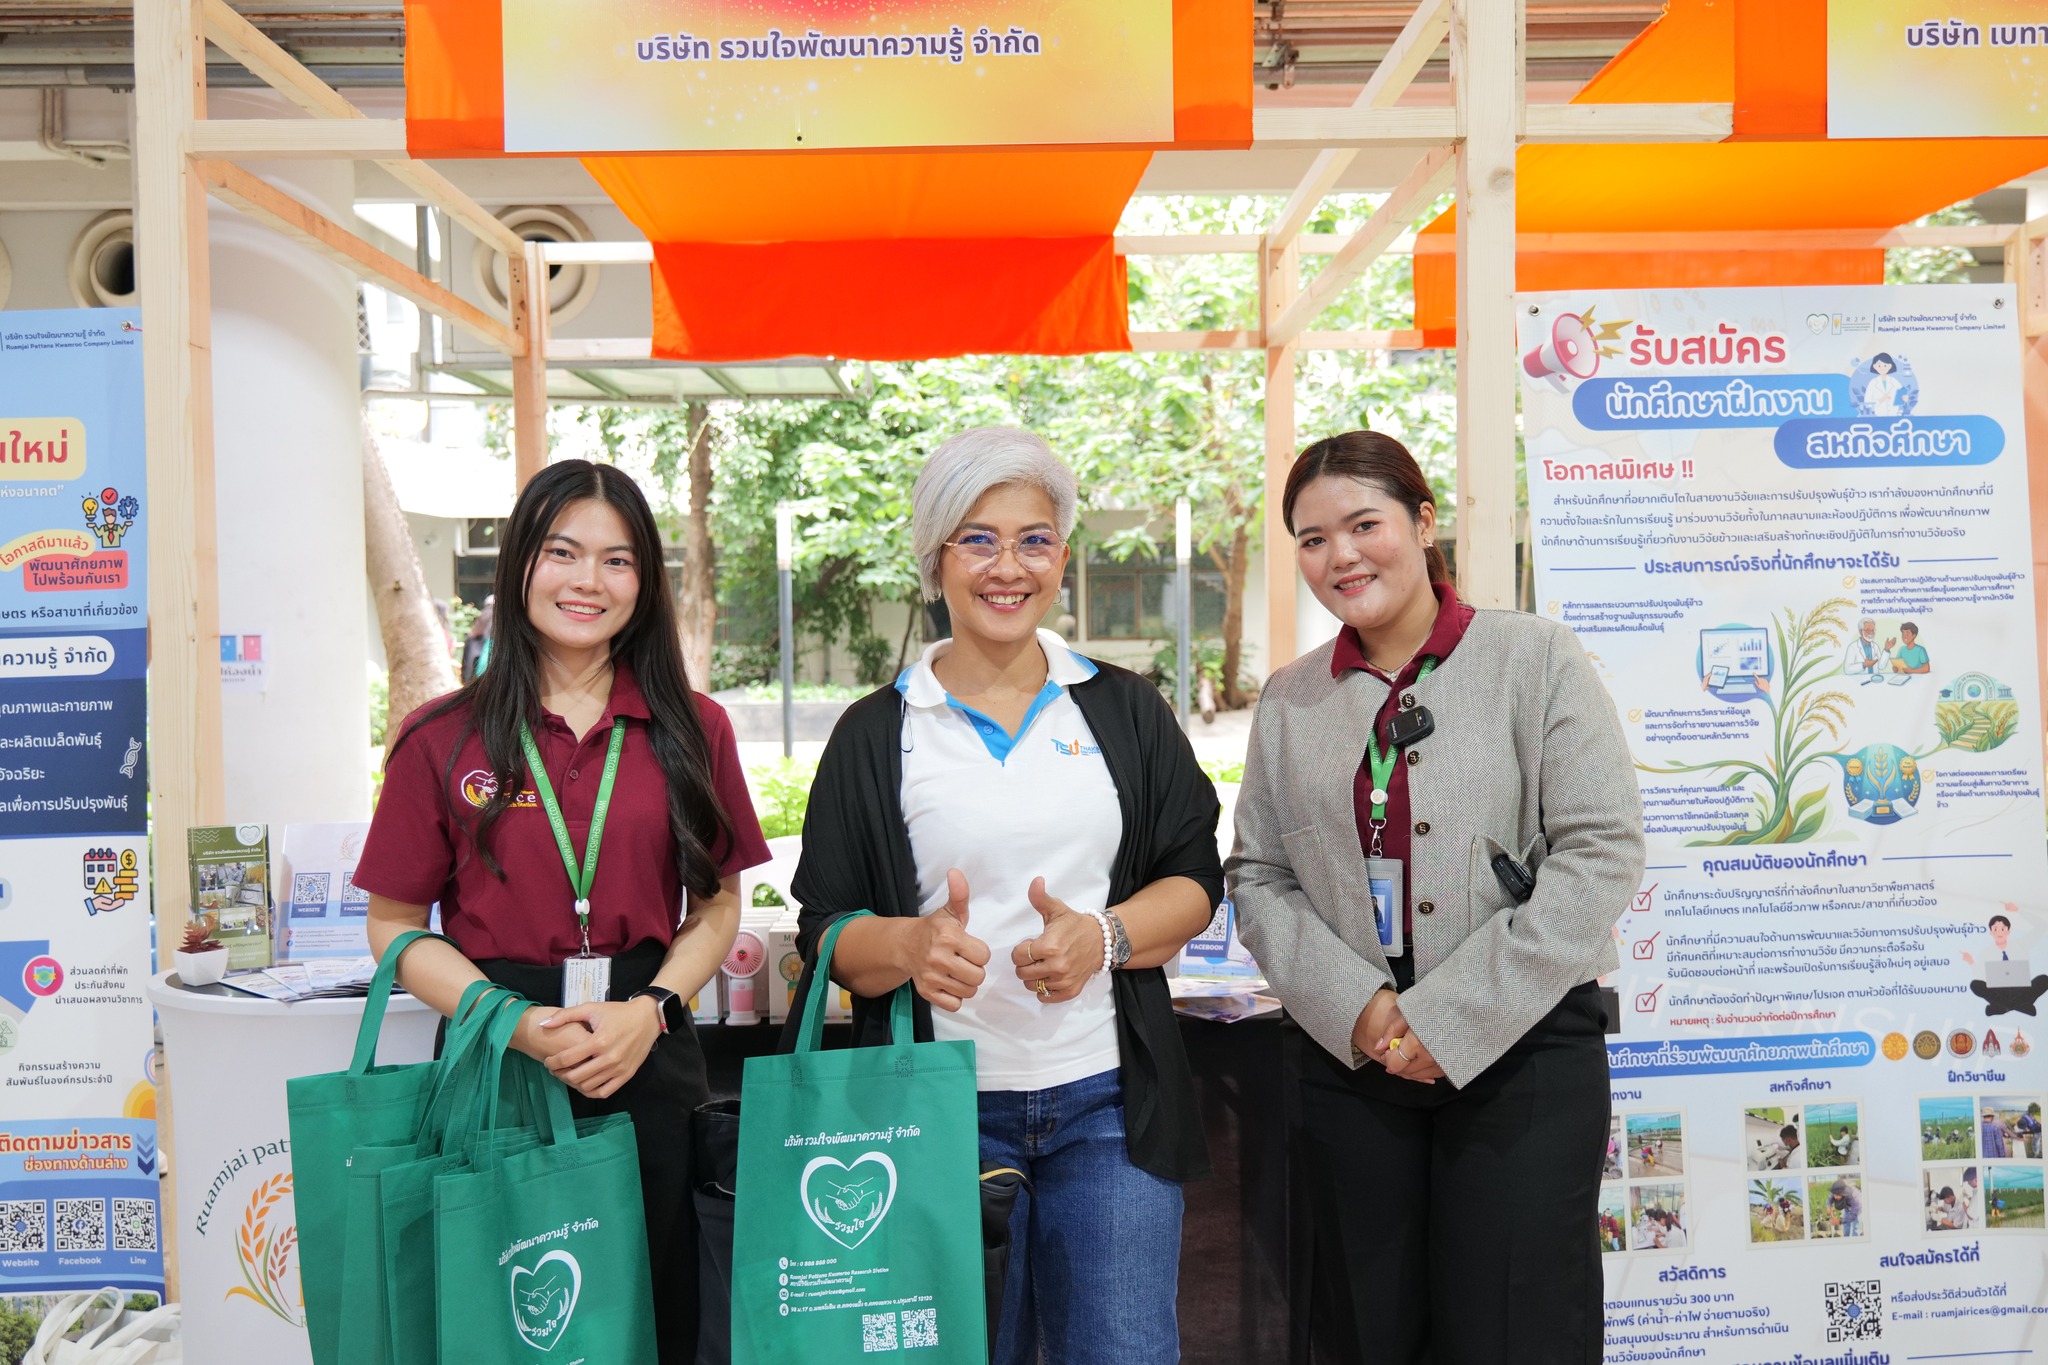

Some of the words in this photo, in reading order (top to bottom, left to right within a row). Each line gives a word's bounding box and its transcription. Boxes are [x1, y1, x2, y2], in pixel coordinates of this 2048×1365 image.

[1907, 20, 1979, 46] บริษัท
[636, 35, 711, 61] บริษัท
[720, 27, 964, 63] รวมใจพัฒนาความรู้
[973, 28, 1040, 57] จำกัด
[1954, 324, 1982, 332] Company
[1630, 323, 1786, 366] รับสมัคร
[1606, 378, 1832, 419] นักศึกษาฝึกงาน
[1806, 418, 1971, 459] สหกิจศึกษา
[1543, 459, 1675, 481] โอกาสพิเศษ
[1682, 460, 1694, 478] !!
[1553, 488, 1867, 506] สำหรับนักศึกษาที่อยากเติบโตในสายงานวิจัยและการปรับปรุงพันธุ์ข้าว
[1869, 482, 1995, 499] เรากำลังมองหานักศึกษาที่มี
[1540, 511, 1674, 527] ความตั้งใจและรักในการเรียนรู้
[1675, 507, 1898, 523] มาร่วมงานวิจัยทั้งในภาคสนามและห้องปฏิบัติการ
[1899, 504, 1990, 518] เพื่อพัฒนาศักยภาพ
[0, 535, 89, 566] โอกาสดีมาแล้ว
[29, 557, 123, 571] พัฒนาศักยภาพ
[1644, 549, 1900, 574] ประสบการณ์จริงที่นักศึกษาจะได้รับ
[33, 572, 121, 586] ไปพร้อมกับเรา
[31, 602, 138, 618] หรือสาขาที่เกี่ยวข้อง
[1572, 622, 1665, 633] รส่งเสริมและผลิตเมล็ดพันธุ์
[0, 647, 58, 669] ความรู้
[64, 647, 107, 664] จำกัด
[0, 700, 113, 716] ณภาพและกายภาพ
[1643, 796, 1754, 808] ุณภาพดินภายในห้องปฏิบัติการ
[546, 797, 575, 867] WWW.PINEHURST.CO.TH
[586, 800, 607, 871] WWW.PINEHURST.CO.TH
[1644, 822, 1747, 834] พื่อสนับสนุนงานปรับปรุงพันธุ์
[1703, 850, 1867, 877] คุณสมบัติของนักศึกษา
[1664, 880, 1935, 901] นักศึกษาระดับปริญญาตรีที่กำลังศึกษาในสาขาวิชาพืชศาสตร์
[1664, 904, 1740, 917] เทคโนโลยีเกษตร
[1742, 901, 1820, 914] เทคโนโลยีชีวภาพ
[1822, 893, 1938, 911] หรือคณะ/สาขาที่เกี่ยวข้อง
[1666, 923, 1987, 946] นักศึกษาที่มีความสนใจด้านการพัฒนาและวิจัยทางการปรับปรุงพันธุ์ข้าว
[1190, 943, 1224, 951] FACEBOOK
[1666, 945, 1838, 962] มีทัศนคติที่เหมาะสมต่อการทำงานวิจัย
[1839, 941, 1925, 955] มีความกระตือรือร้น
[70, 963, 128, 976] ส่วนลดค่าที่พัก
[1667, 962, 1756, 978] รับผิดชอบต่อหน้าที่
[1758, 957, 1912, 975] และพร้อมเปิดรับการเรียนรู้สิ่งใหม่ๆ
[1913, 956, 1950, 972] อยู่เสมอ
[75, 980, 125, 990] ประกันสังคม
[1669, 989, 1845, 1007] นักศึกษาต้องจัดทำปัญหาพิเศษ/โปรเจค
[1847, 981, 1967, 998] ตามหัวข้อที่ได้รับมอบหมาย
[55, 994, 143, 1004] นำเสนอผลงานวิชาการ
[1670, 1016, 1709, 1028] หมายเหตุ
[1716, 1009, 1836, 1025] รับจำนวนจำกัดต่อปีการศึกษา
[18, 1061, 101, 1072] กิจกรรมสร้างความ
[6, 1074, 113, 1086] สัมพันธ์ในองค์กรประจำปี
[1770, 1077, 1831, 1093] สหกิจศึกษา
[1947, 1070, 2006, 1083] ฝึกวิชาชีพ
[1611, 1090, 1642, 1101] กงาน
[0, 1128, 132, 1152] ติดตามข่าวสาร
[895, 1124, 921, 1140] จำกัด
[24, 1153, 128, 1172] ช่องทางด้านล่าง
[195, 1148, 250, 1238] Ruamjai
[252, 1138, 292, 1165] pat
[571, 1217, 599, 1233] จำกัด
[2, 1259, 39, 1268] Website
[59, 1257, 102, 1265] Facebook
[130, 1256, 147, 1265] Line
[1879, 1241, 1980, 1267] สนใจสมัครได้ที่
[1658, 1265, 1726, 1283] สวัสดิการ
[1603, 1293, 1687, 1310] าตอบแทนรายวัน
[1690, 1294, 1711, 1304] 300
[1713, 1292, 1735, 1302] บาท
[1890, 1282, 2007, 1303] หรือส่งประวัติส่วนตัวได้ที่
[1704, 1306, 1771, 1321] จ่ายตามจริง)
[1892, 1310, 1923, 1321] E-mail
[1604, 1331, 1701, 1348] นับสนุนงบประมาณ
[1703, 1322, 1789, 1339] สำหรับการดำเนิน
